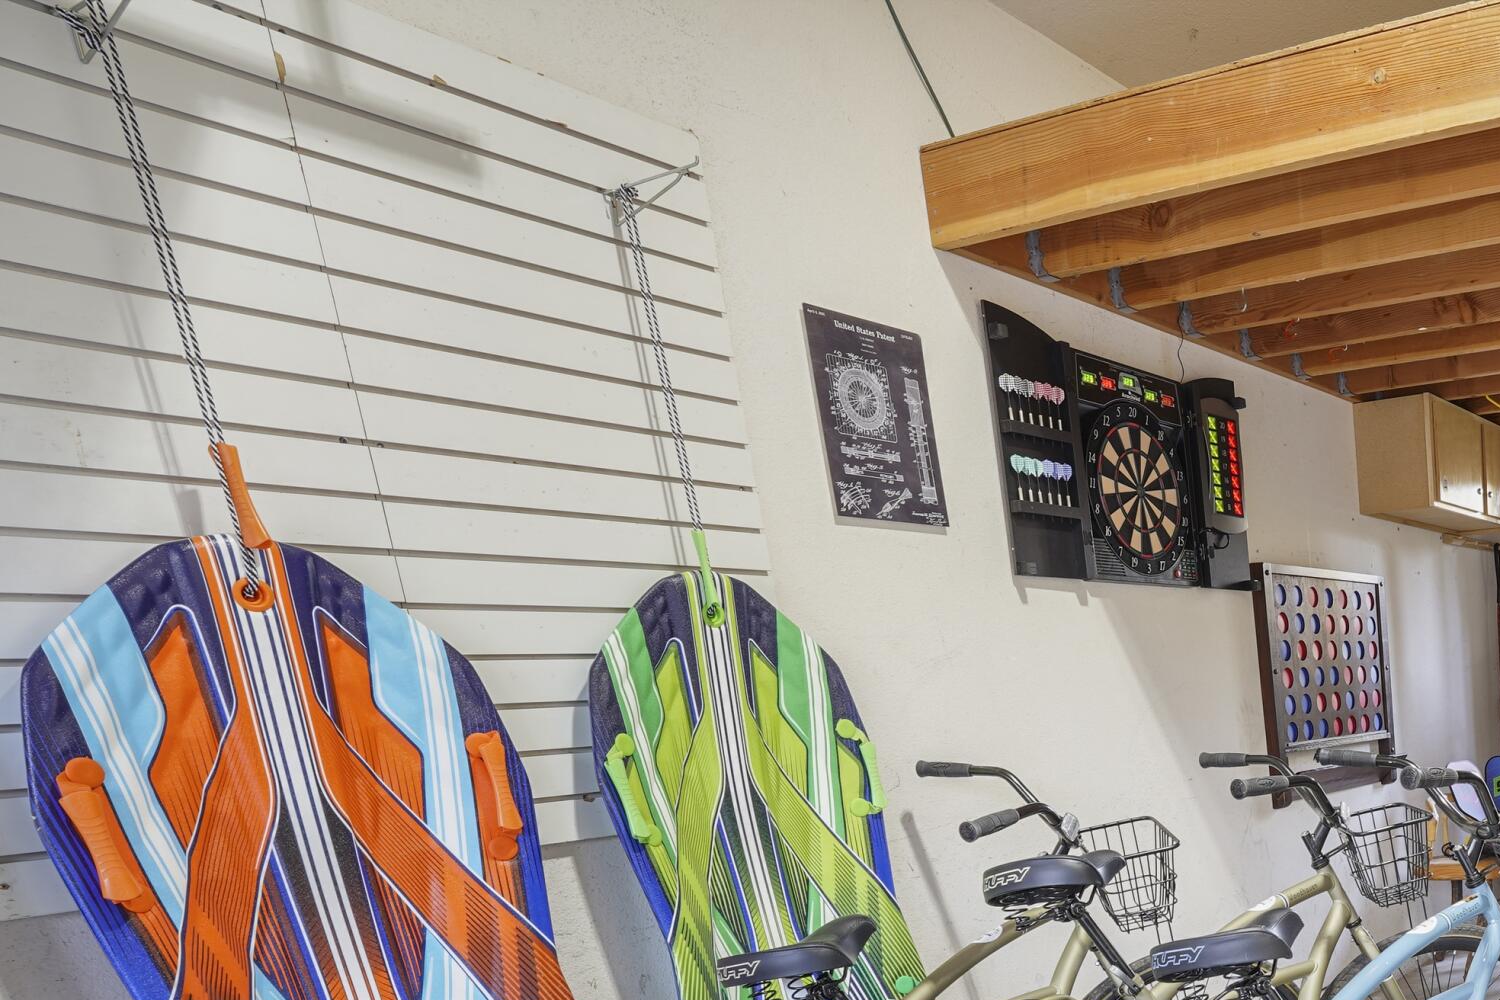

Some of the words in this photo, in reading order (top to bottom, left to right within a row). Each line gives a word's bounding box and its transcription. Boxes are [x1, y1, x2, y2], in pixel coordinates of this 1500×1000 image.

[833, 319, 855, 333] United
[856, 326, 875, 338] States
[876, 330, 896, 342] Patent
[1116, 407, 1120, 418] 5
[1129, 407, 1136, 418] 20
[1103, 416, 1110, 426] 12
[1145, 415, 1149, 425] 1
[1094, 429, 1099, 439] 9
[1158, 430, 1164, 440] 18
[1169, 447, 1174, 457] 4
[1088, 452, 1096, 463] 14
[1177, 471, 1184, 481] 13
[1090, 478, 1096, 488] 11
[1184, 494, 1188, 504] 6
[1095, 504, 1100, 514] 8
[1105, 526, 1112, 536] 16
[1178, 536, 1184, 546] 15
[1118, 546, 1123, 557] 7
[1171, 551, 1176, 561] 2
[1131, 556, 1138, 567] 19
[1160, 560, 1166, 570] 17
[1147, 563, 1152, 574] 3
[717, 960, 761, 982] UFFY
